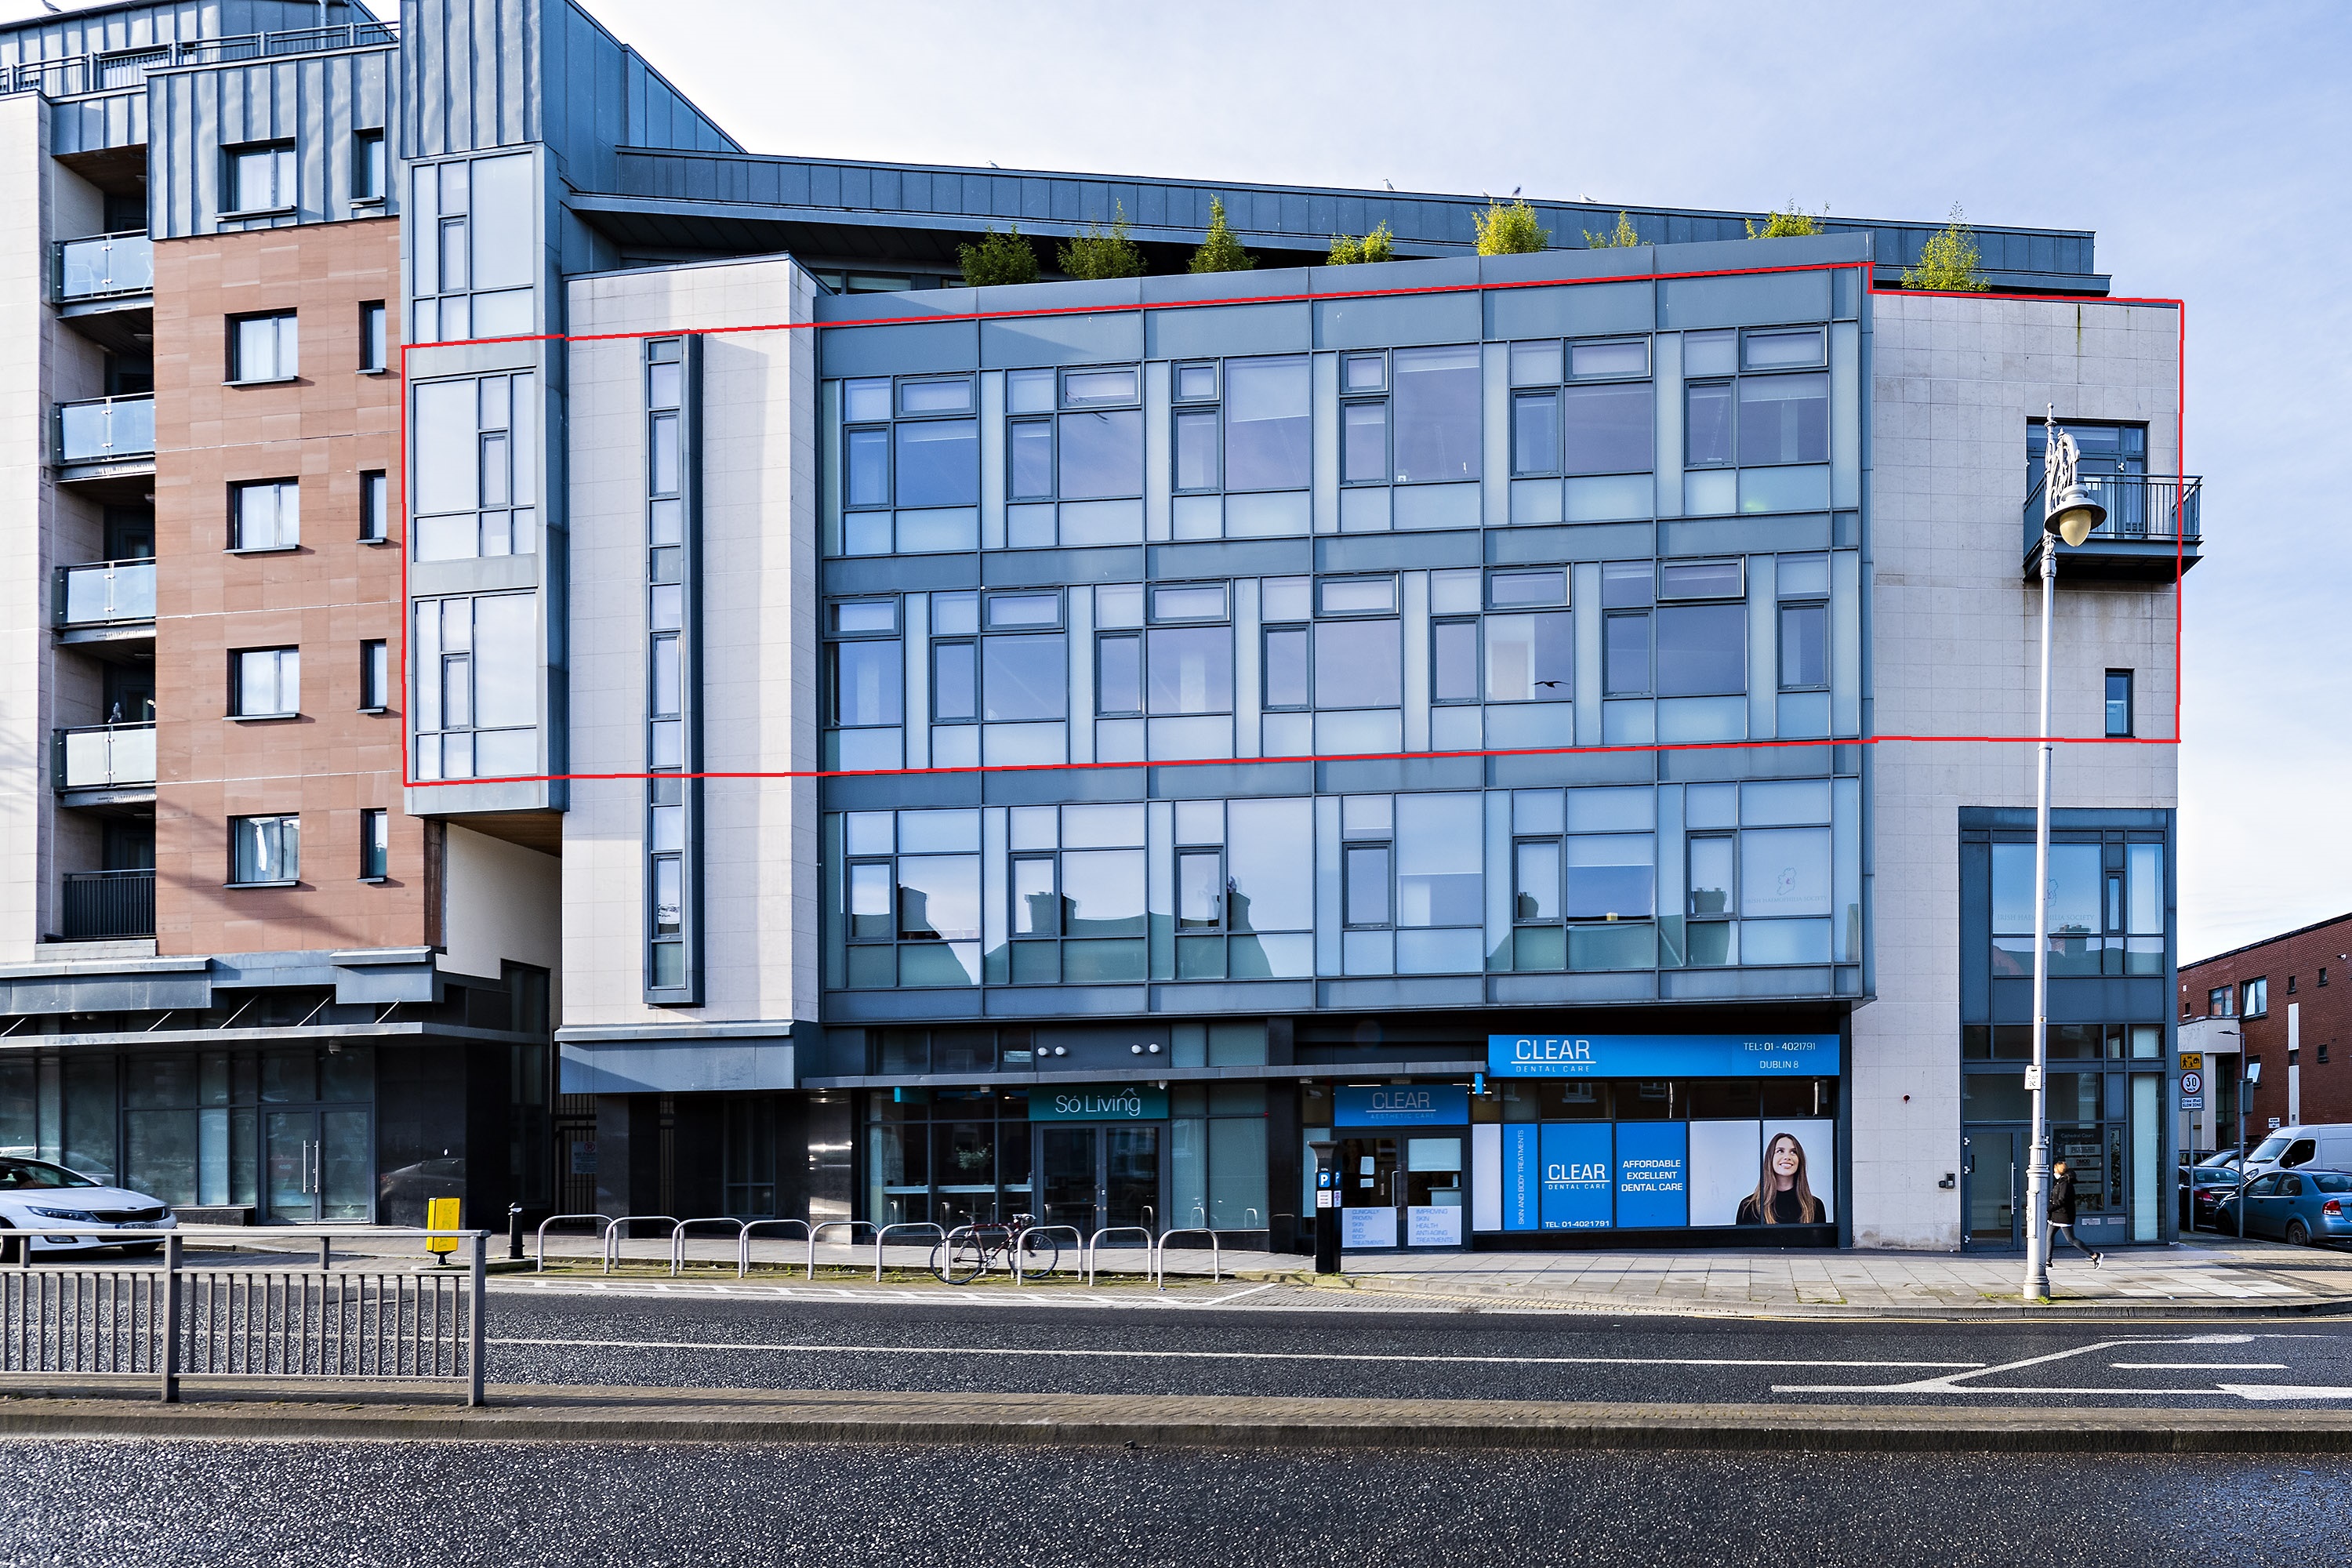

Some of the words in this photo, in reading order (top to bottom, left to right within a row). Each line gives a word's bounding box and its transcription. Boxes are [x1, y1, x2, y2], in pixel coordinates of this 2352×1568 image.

[1515, 1040, 1590, 1060] CLEAR
[1759, 1060, 1791, 1069] DUBLIN
[2186, 1077, 2197, 1087] 30
[1055, 1094, 1081, 1113] Só
[1085, 1092, 1141, 1116] Living
[1372, 1092, 1430, 1109] CLEAR
[1622, 1160, 1681, 1168] AFFORDABLE
[1548, 1164, 1606, 1180] CLEAR
[1627, 1171, 1677, 1180] EXCELLENT
[1320, 1174, 1328, 1185] P
[1621, 1183, 1657, 1192] DENTAL
[1659, 1182, 1683, 1191] CARE
